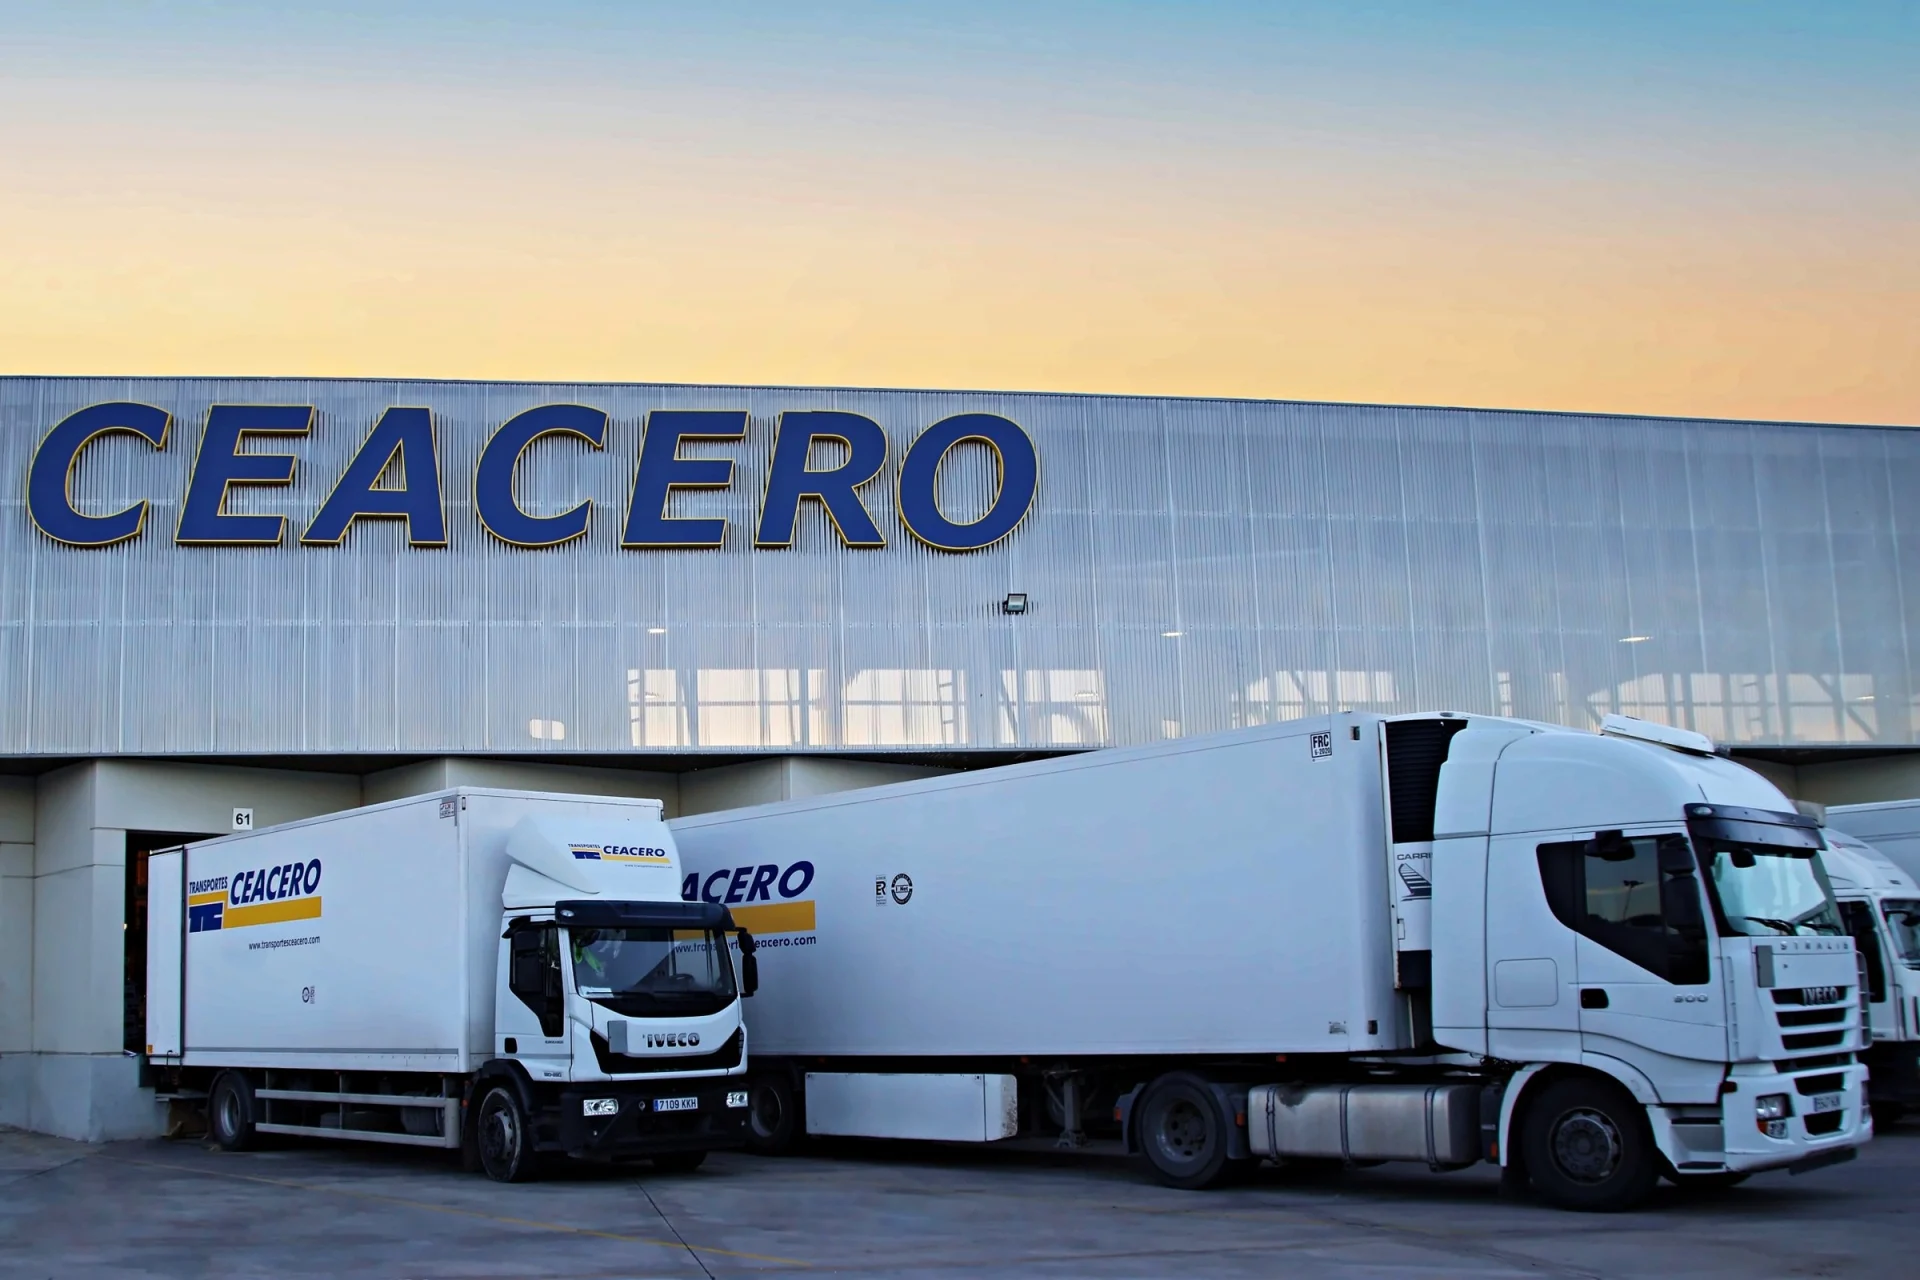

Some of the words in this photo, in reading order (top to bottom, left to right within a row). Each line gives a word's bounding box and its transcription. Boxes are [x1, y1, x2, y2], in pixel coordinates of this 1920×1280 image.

[26, 400, 1040, 550] CEACERO
[1312, 734, 1329, 748] FRC
[235, 812, 250, 826] 61
[603, 845, 666, 857] CEACERO
[189, 876, 228, 894] TRANSPORTES
[230, 858, 322, 906] CEACERO
[248, 935, 321, 951] www.transportesceacero.com
[1802, 986, 1839, 1005] IVECO
[647, 1032, 700, 1048] IVECO
[659, 1100, 680, 1110] 7109
[681, 1098, 697, 1109] KKH
